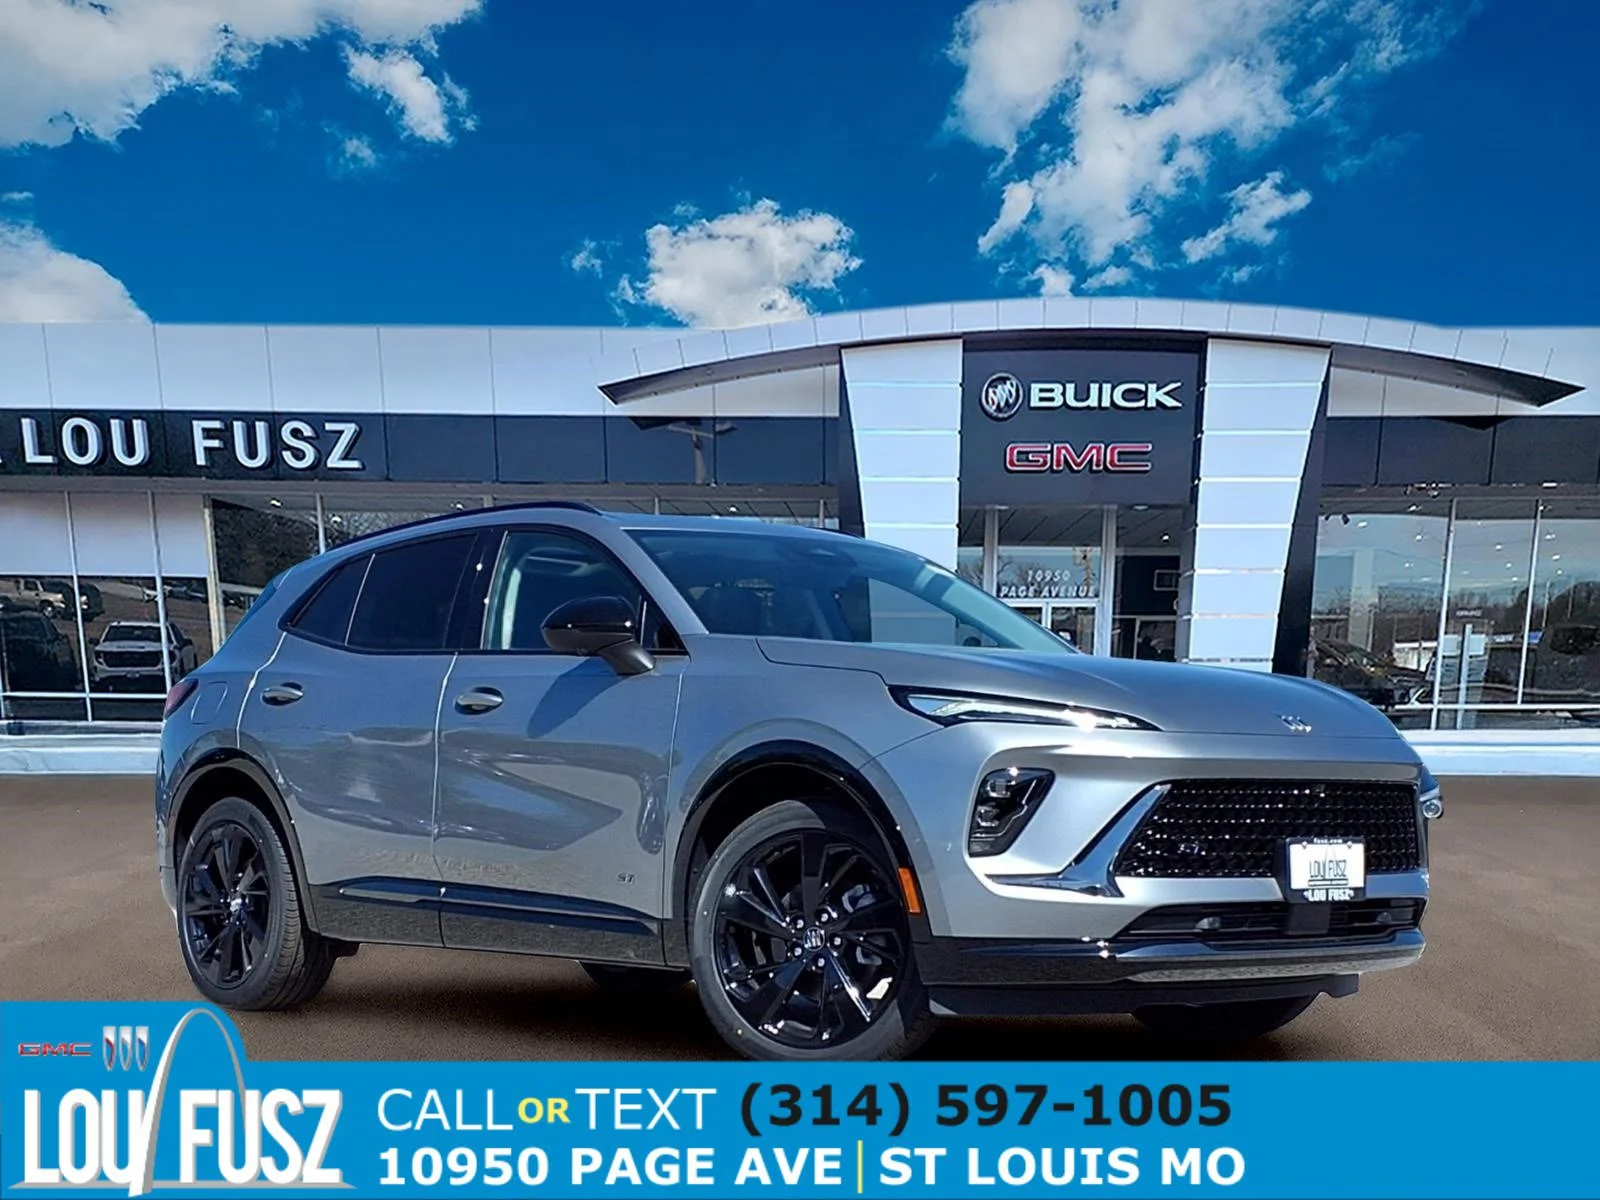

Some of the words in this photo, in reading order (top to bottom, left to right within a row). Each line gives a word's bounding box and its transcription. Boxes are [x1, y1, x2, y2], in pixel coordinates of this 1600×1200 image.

[1029, 381, 1182, 409] BUICK
[20, 416, 150, 467] LOU
[192, 419, 363, 470] FUSZ
[1005, 443, 1152, 473] GMC
[1027, 570, 1071, 582] 10950
[1000, 585, 1036, 598] PAGE
[1040, 585, 1096, 598] AVENUE
